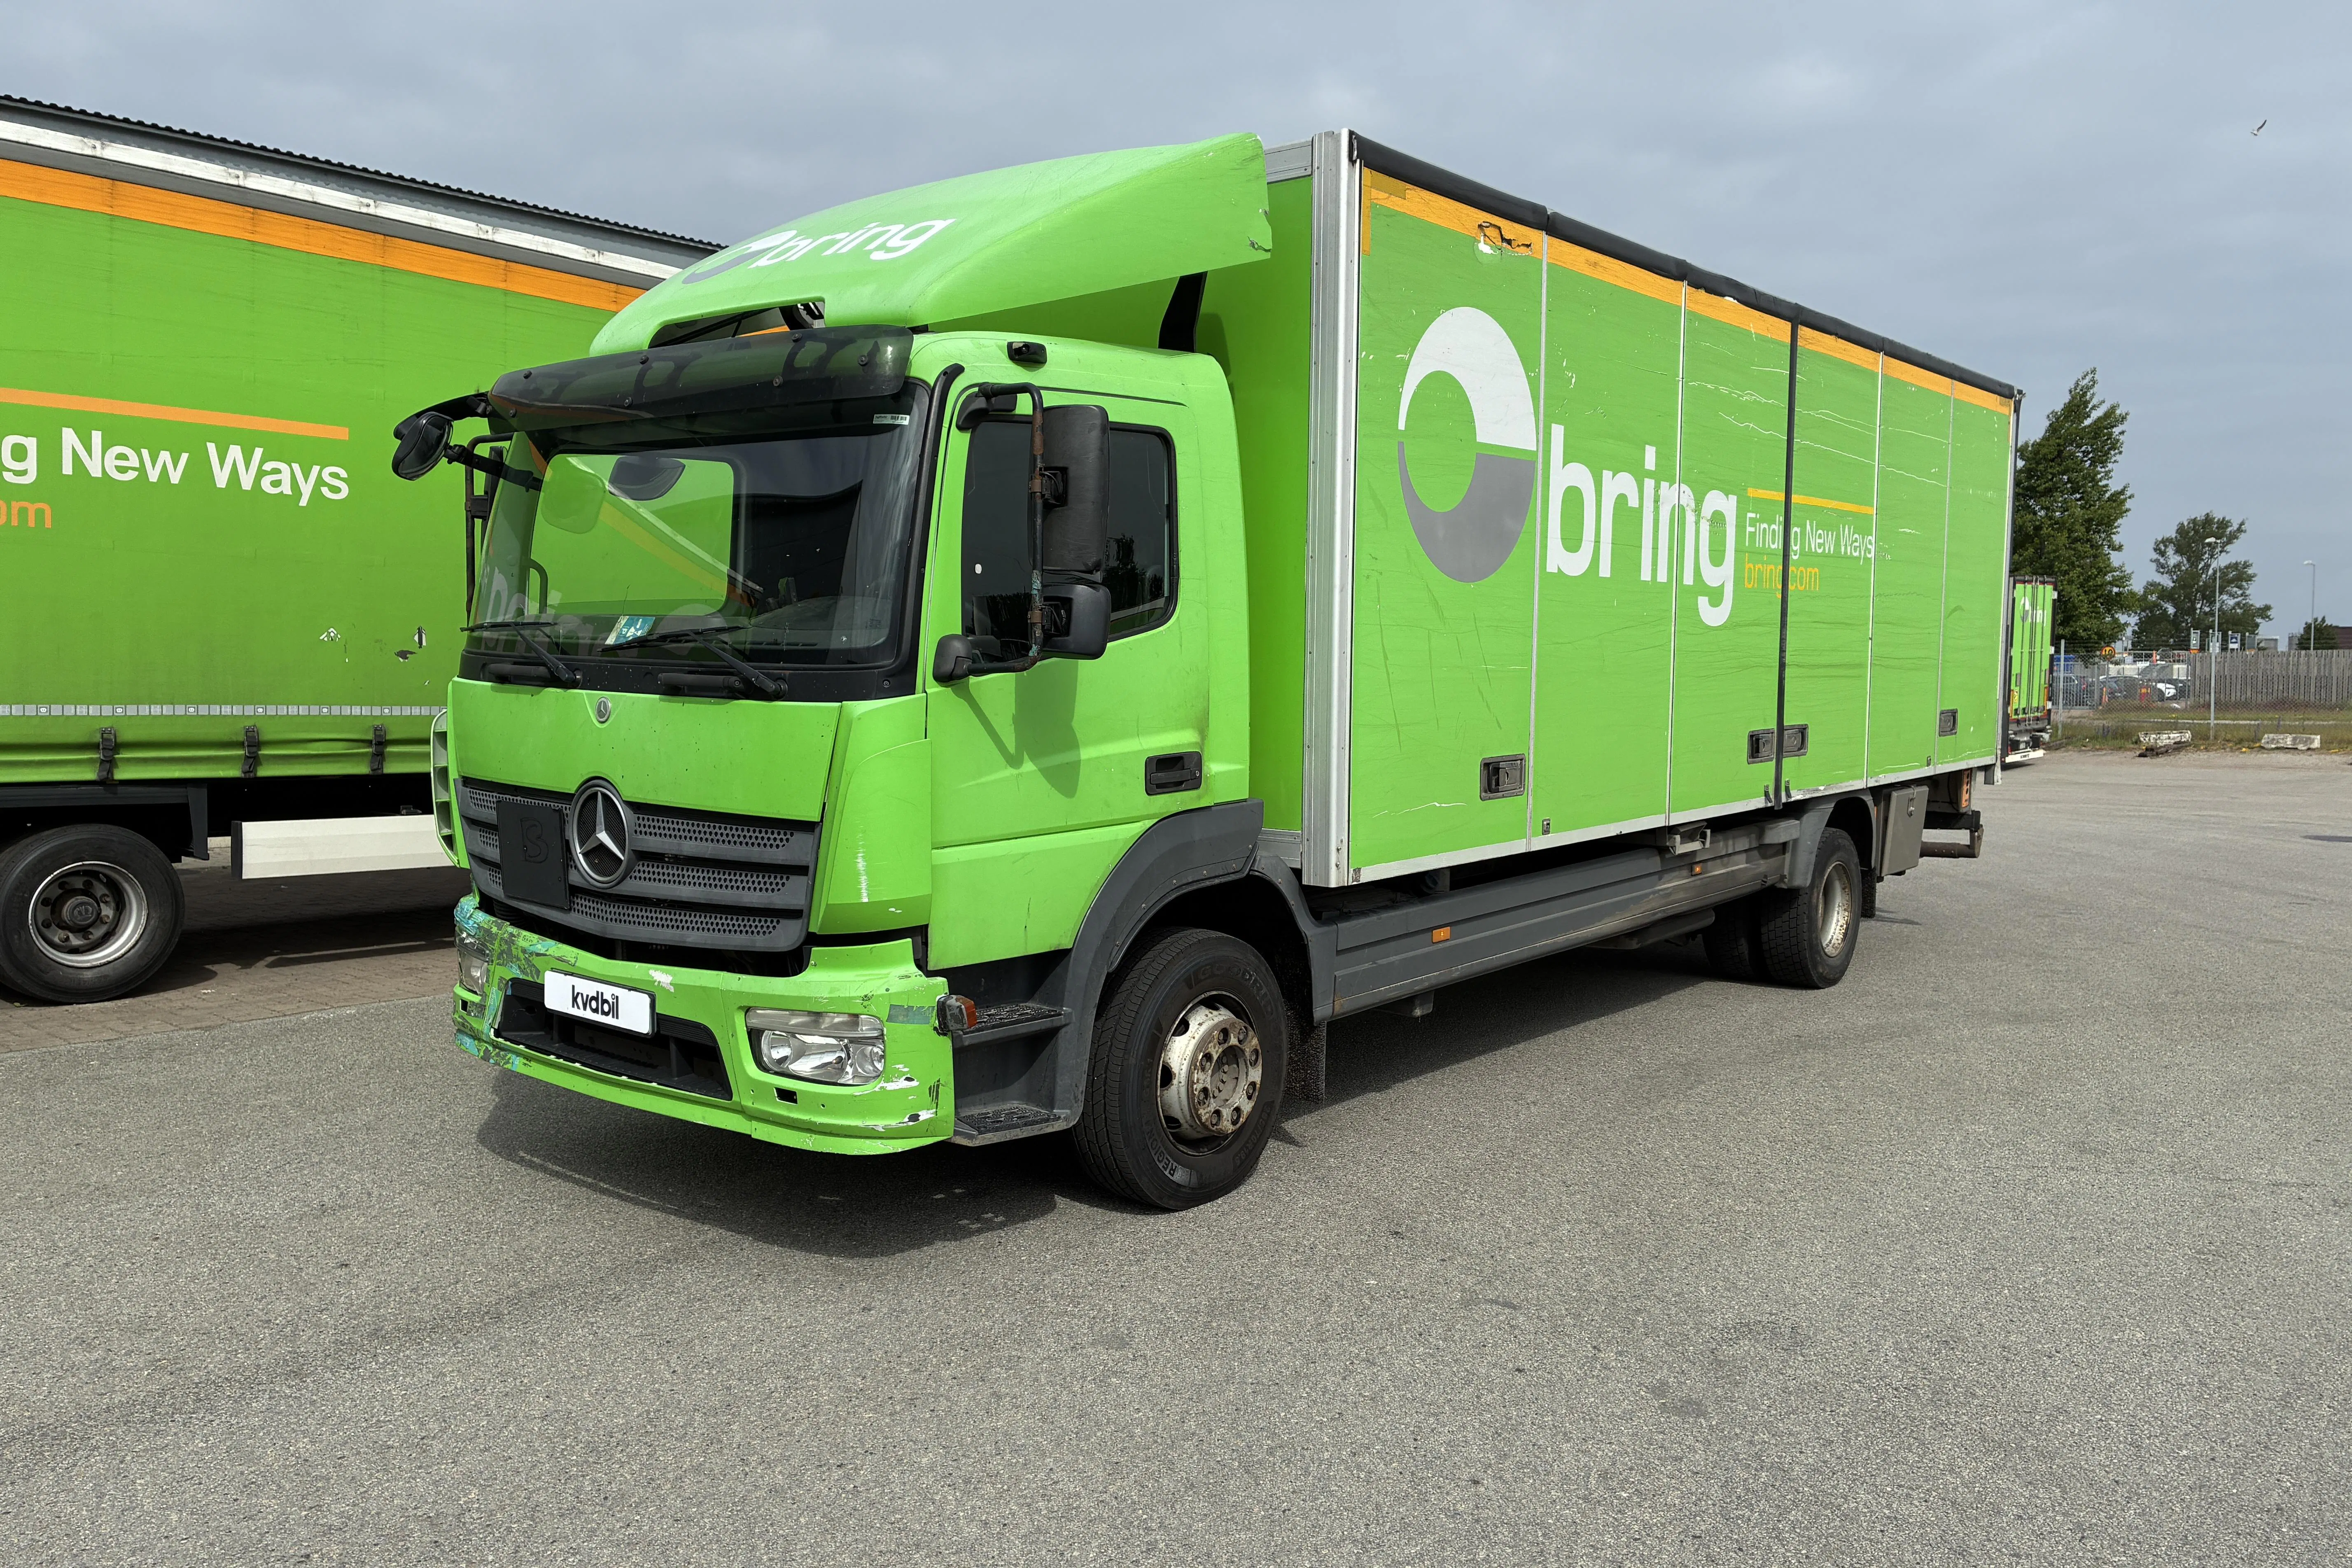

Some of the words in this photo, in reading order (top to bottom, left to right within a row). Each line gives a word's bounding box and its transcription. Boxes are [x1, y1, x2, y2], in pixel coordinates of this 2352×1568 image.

[747, 218, 957, 269] bring
[62, 427, 189, 484] New
[206, 442, 349, 506] Ways
[1546, 423, 1737, 627] bring
[1745, 512, 1801, 560] Findig
[1806, 520, 1836, 554] New
[1840, 523, 1874, 565] Ways
[1745, 552, 1819, 599] bringcom
[572, 985, 619, 1020] kvdbil
